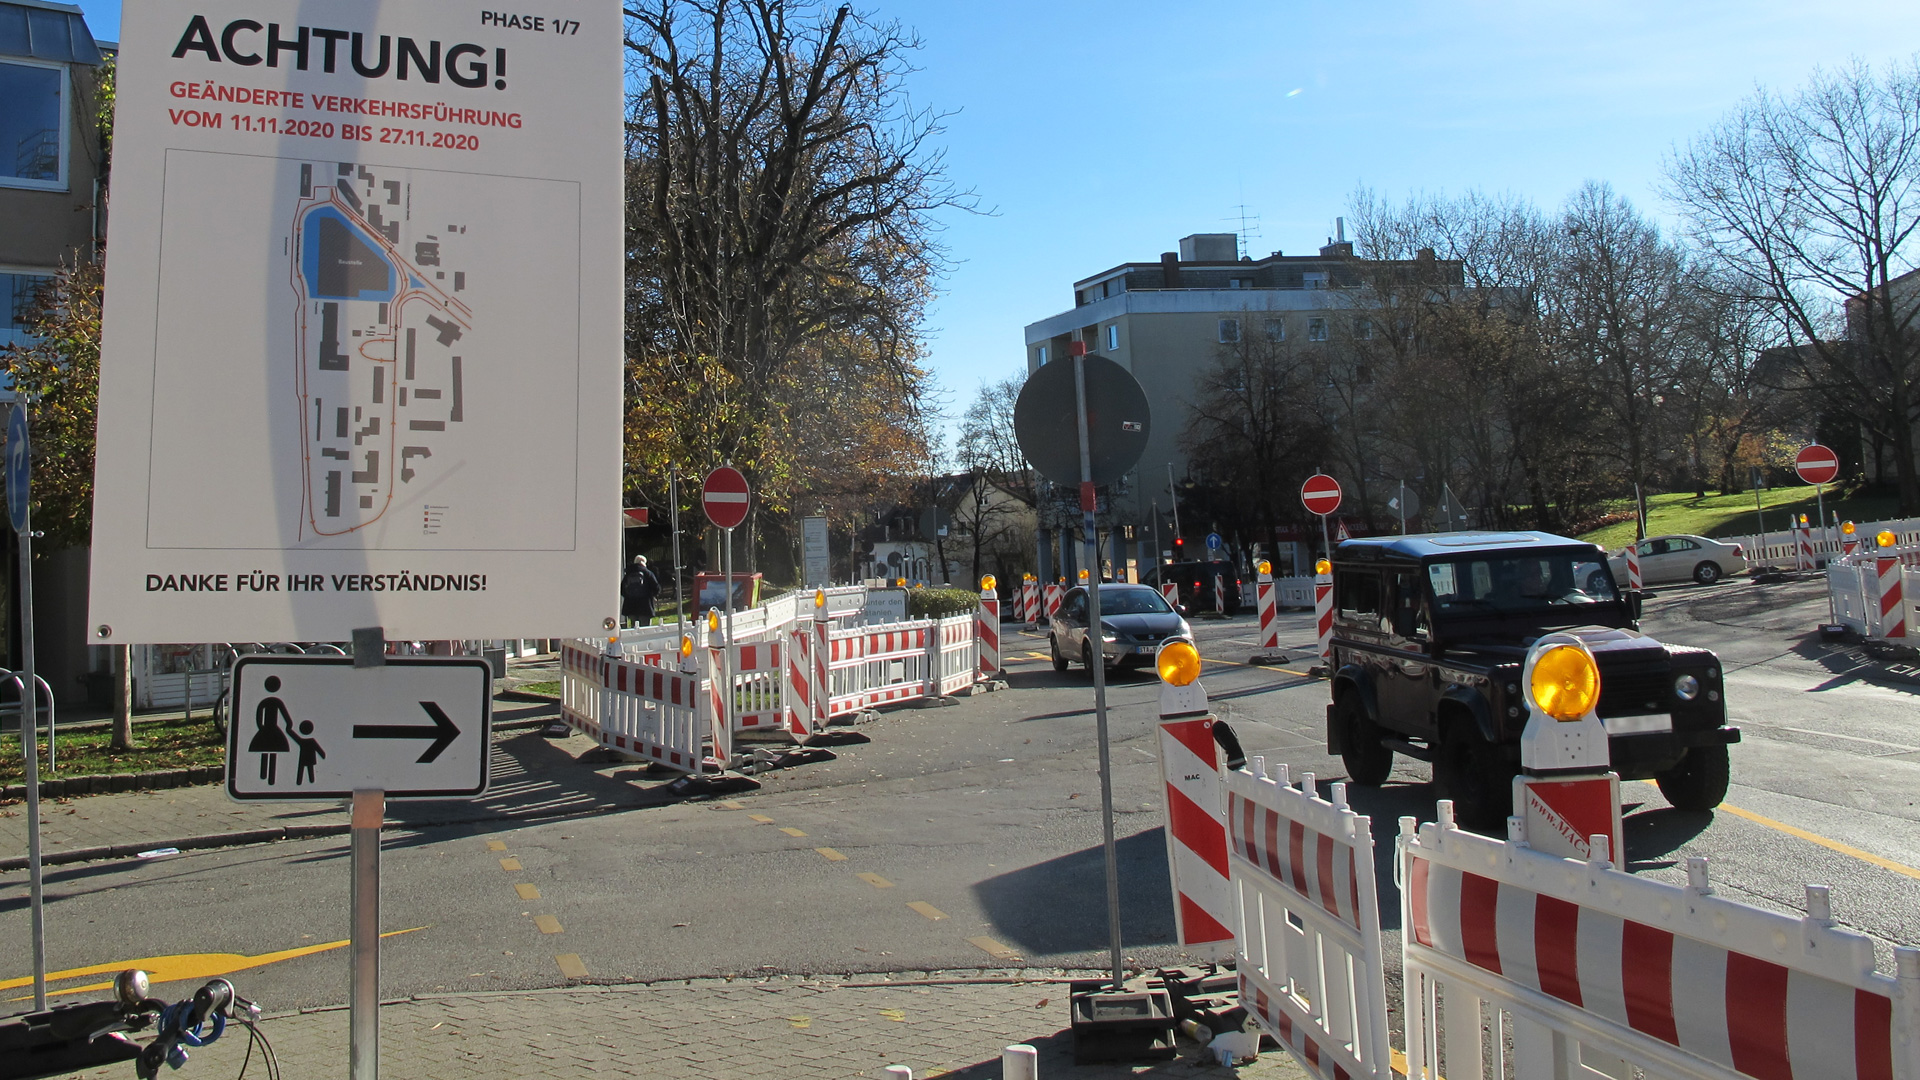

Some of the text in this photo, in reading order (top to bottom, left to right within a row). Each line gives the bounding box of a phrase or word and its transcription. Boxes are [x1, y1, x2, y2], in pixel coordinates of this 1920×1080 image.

[481, 11, 581, 36] PHASE 1/7
[171, 14, 508, 91] ACHTUNG!
[169, 80, 523, 129] GEÄNDERTE VERKEHRSFÜHRUNG
[168, 108, 480, 152] VOM 11.11.2020 BIS 27.11.2020
[145, 569, 488, 592] DANKE FÜR IHR VERSTÄNDNIS!
[1184, 773, 1200, 781] MAC
